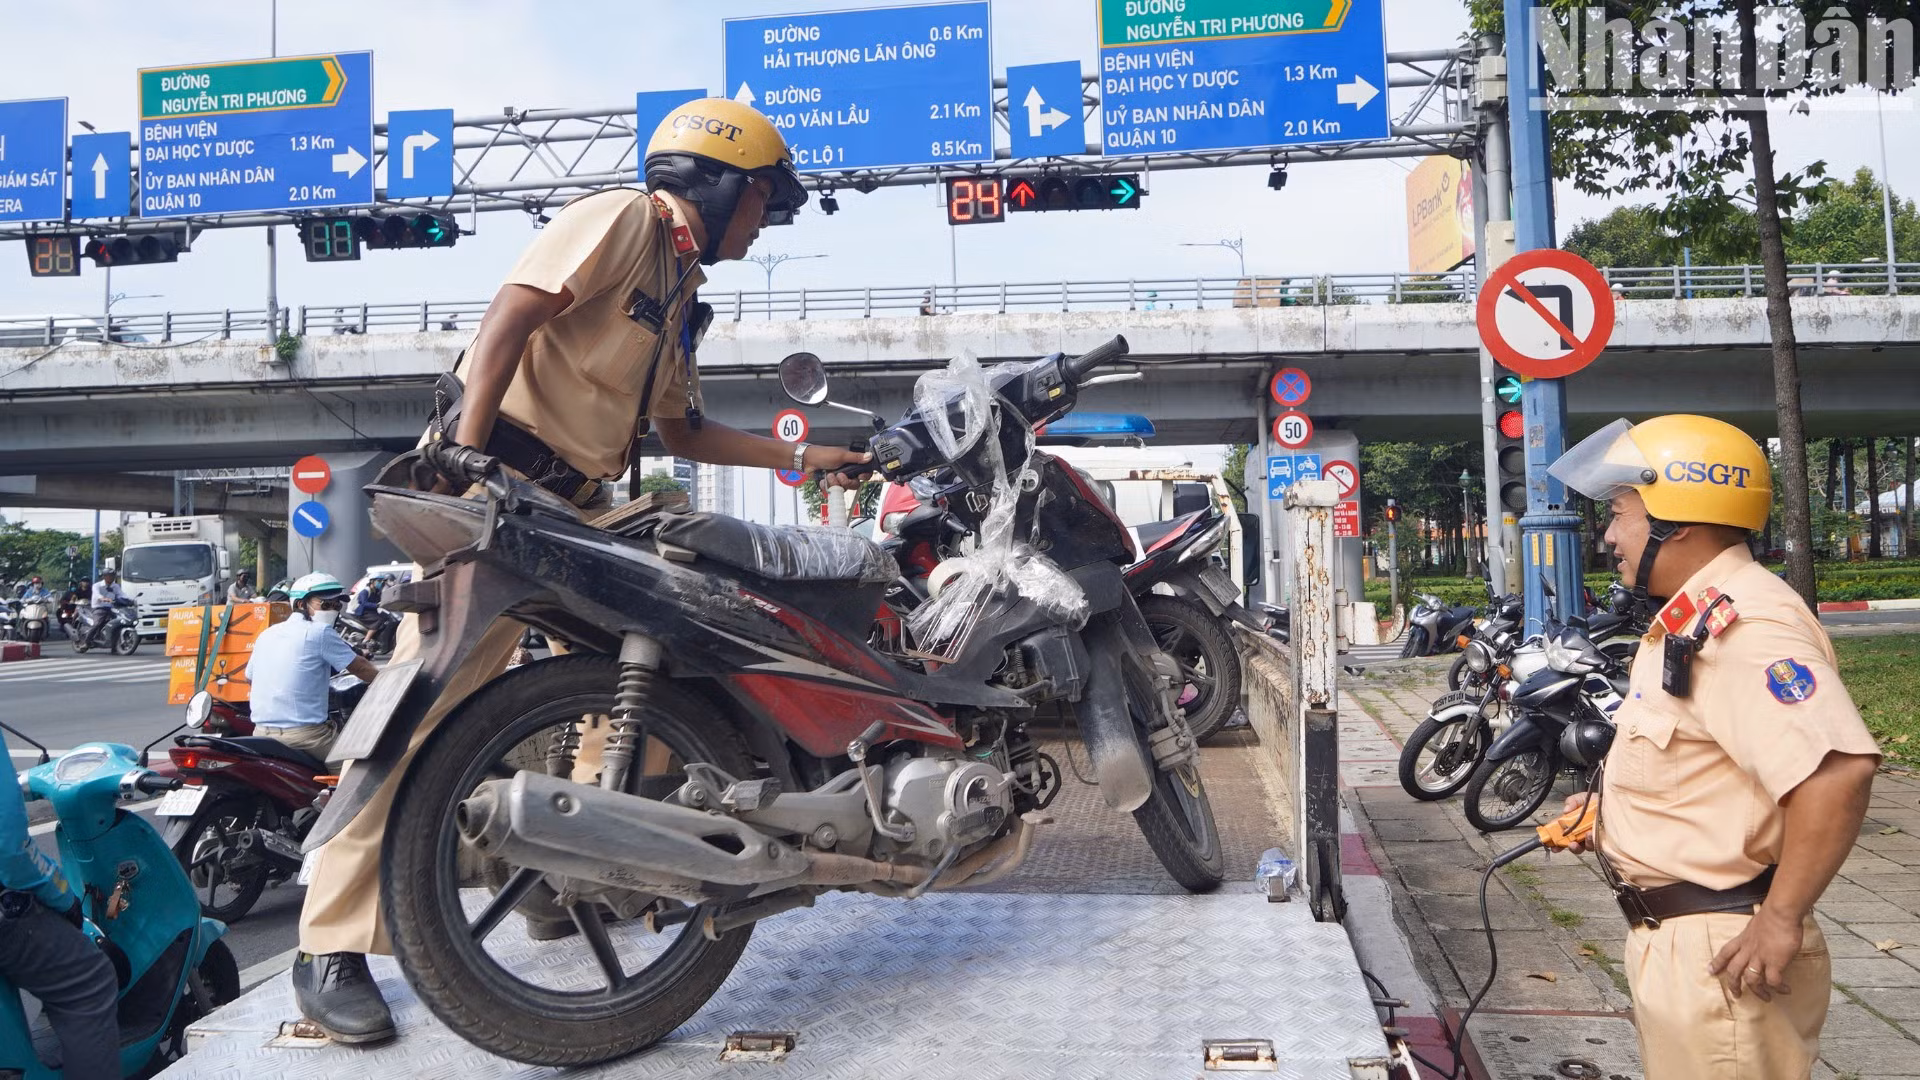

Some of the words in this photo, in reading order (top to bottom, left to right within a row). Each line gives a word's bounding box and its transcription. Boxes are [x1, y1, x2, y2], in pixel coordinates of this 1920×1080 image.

[764, 24, 820, 44] ĐƯỜNG
[930, 26, 952, 42] 0.6
[956, 24, 982, 40] Km
[1127, 16, 1195, 40] NGUYỄN
[1200, 18, 1226, 35] TRI
[1231, 12, 1304, 33] PHƯƠNG
[764, 48, 790, 69] HẢI
[794, 48, 860, 68] THƯỢNG
[864, 44, 897, 62] LÃN
[902, 41, 936, 60] ÔNG
[1104, 52, 1150, 74] BỆNH
[1155, 48, 1194, 70] VIỆN
[161, 72, 210, 92] ĐƯỜNG
[1106, 77, 1134, 96] ĐẠI
[1139, 75, 1174, 94] HỌC
[1177, 74, 1188, 88] Y
[1193, 69, 1239, 89] DƯỢC
[1284, 65, 1304, 82] 1.3
[1310, 64, 1338, 80] Km
[162, 91, 218, 114] NGUYỄN
[222, 94, 244, 108] TRI
[247, 88, 307, 107] PHƯƠNG
[765, 85, 822, 106] ĐƯỜNG
[800, 108, 832, 128] VĂN
[838, 103, 870, 126] LẦU
[930, 104, 949, 120] 2.1
[954, 102, 980, 118] Km
[1106, 104, 1128, 126] UỶ
[1132, 106, 1168, 124] BAN
[1174, 101, 1223, 121] NHÂN
[1228, 98, 1264, 118] DÂN
[144, 123, 182, 143] BỆNH
[186, 120, 218, 140] VIỆN
[672, 114, 742, 142] CSGT
[1284, 120, 1308, 136] 2.0
[1312, 119, 1340, 134] Km
[290, 136, 308, 151] 1.3
[312, 135, 335, 150] Km
[931, 141, 954, 156] 8.5
[956, 140, 982, 156] Km
[1108, 128, 1156, 148] QUẬN
[1160, 128, 1176, 144] 10
[146, 147, 168, 164] ĐẠI
[172, 144, 200, 162] HỌC
[203, 142, 212, 156] Y
[216, 140, 254, 158] DƯỢC
[812, 145, 832, 165] LỘ
[838, 147, 844, 162] 1
[30, 168, 58, 187] SÁT
[146, 171, 163, 190] ỦY
[167, 174, 195, 188] BAN
[200, 168, 240, 186] NHÂN
[244, 166, 275, 184] DÂN
[146, 192, 184, 212] QUẬN
[188, 193, 201, 207] 10
[289, 186, 308, 202] 2.0
[312, 185, 336, 200] Km
[952, 181, 999, 220] 24
[0, 198, 22, 214] ERA
[1412, 189, 1442, 226] LPBank
[783, 420, 798, 437] 60
[1285, 422, 1302, 439] 50
[1664, 460, 1750, 488] CSGT
[173, 612, 194, 620] AURA
